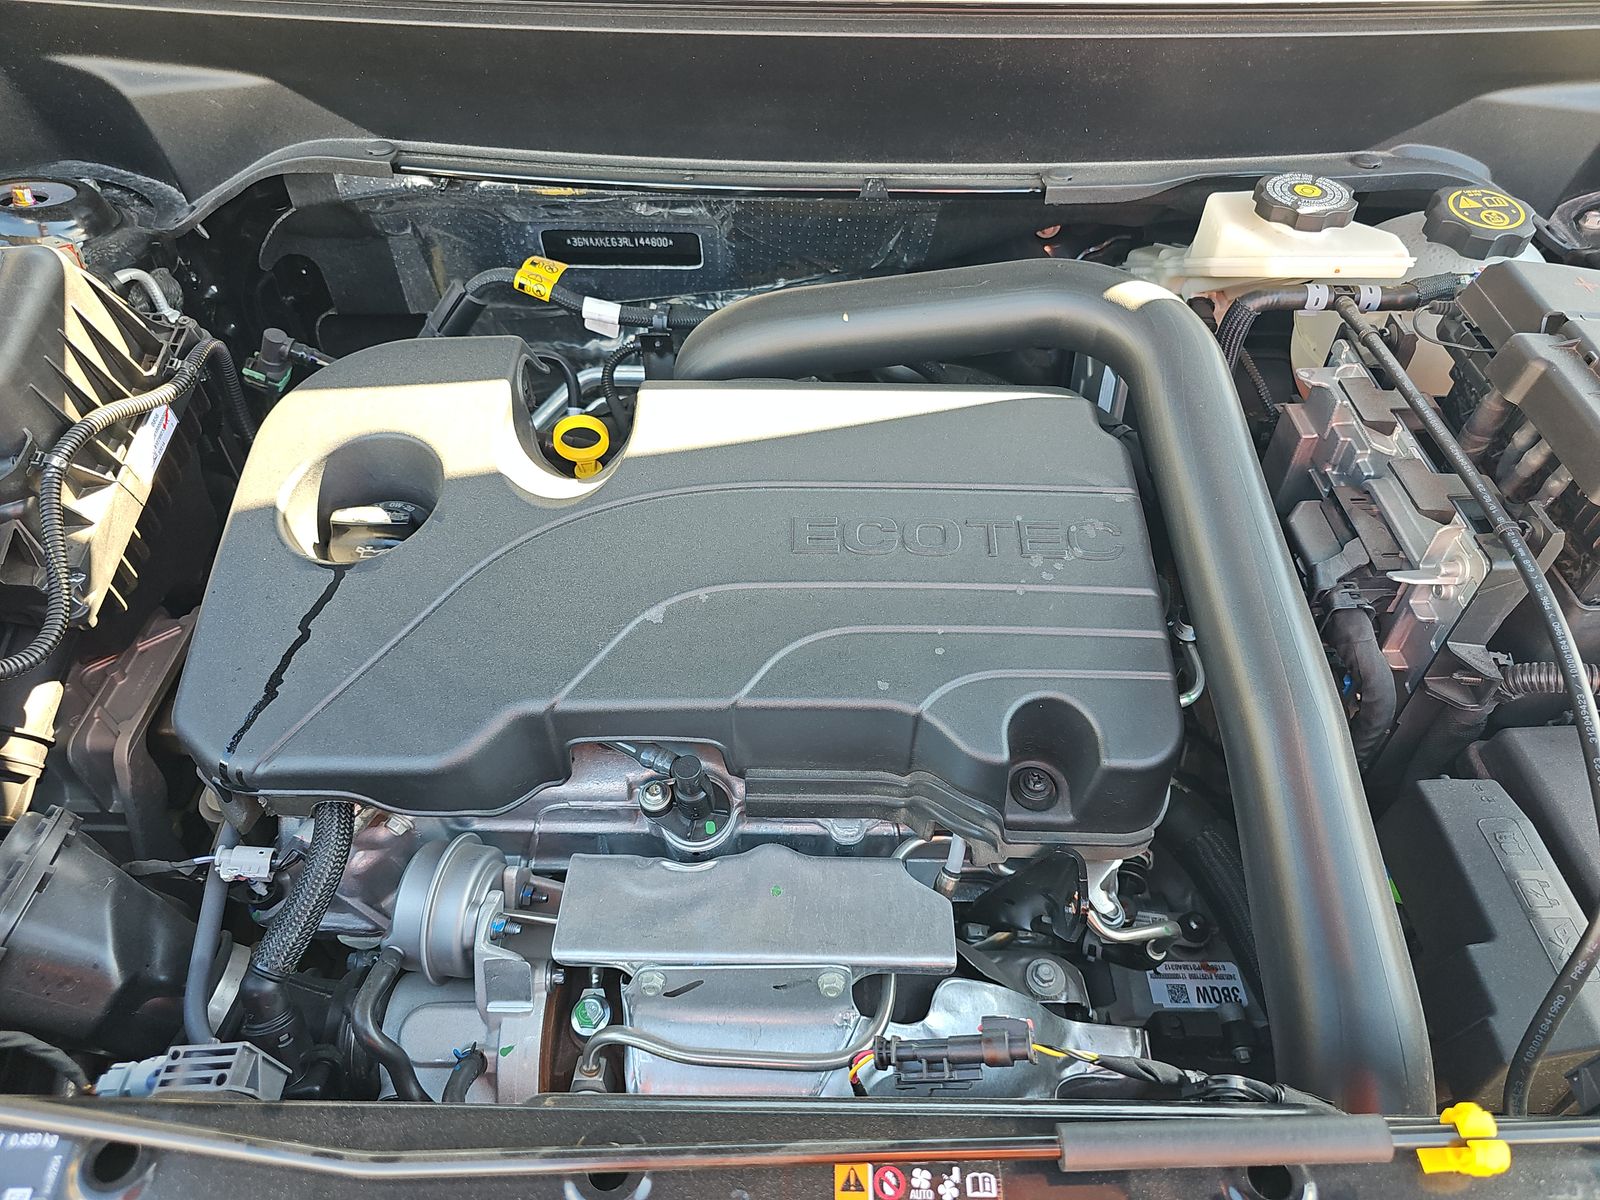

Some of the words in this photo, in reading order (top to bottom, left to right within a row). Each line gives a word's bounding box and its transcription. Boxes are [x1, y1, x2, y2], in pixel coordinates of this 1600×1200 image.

[791, 516, 1125, 561] ECOTEC
[1196, 984, 1242, 1005] 3BQW
[8, 1132, 43, 1147] 0.450
[43, 1132, 60, 1148] kg
[909, 1189, 936, 1200] AUTO
